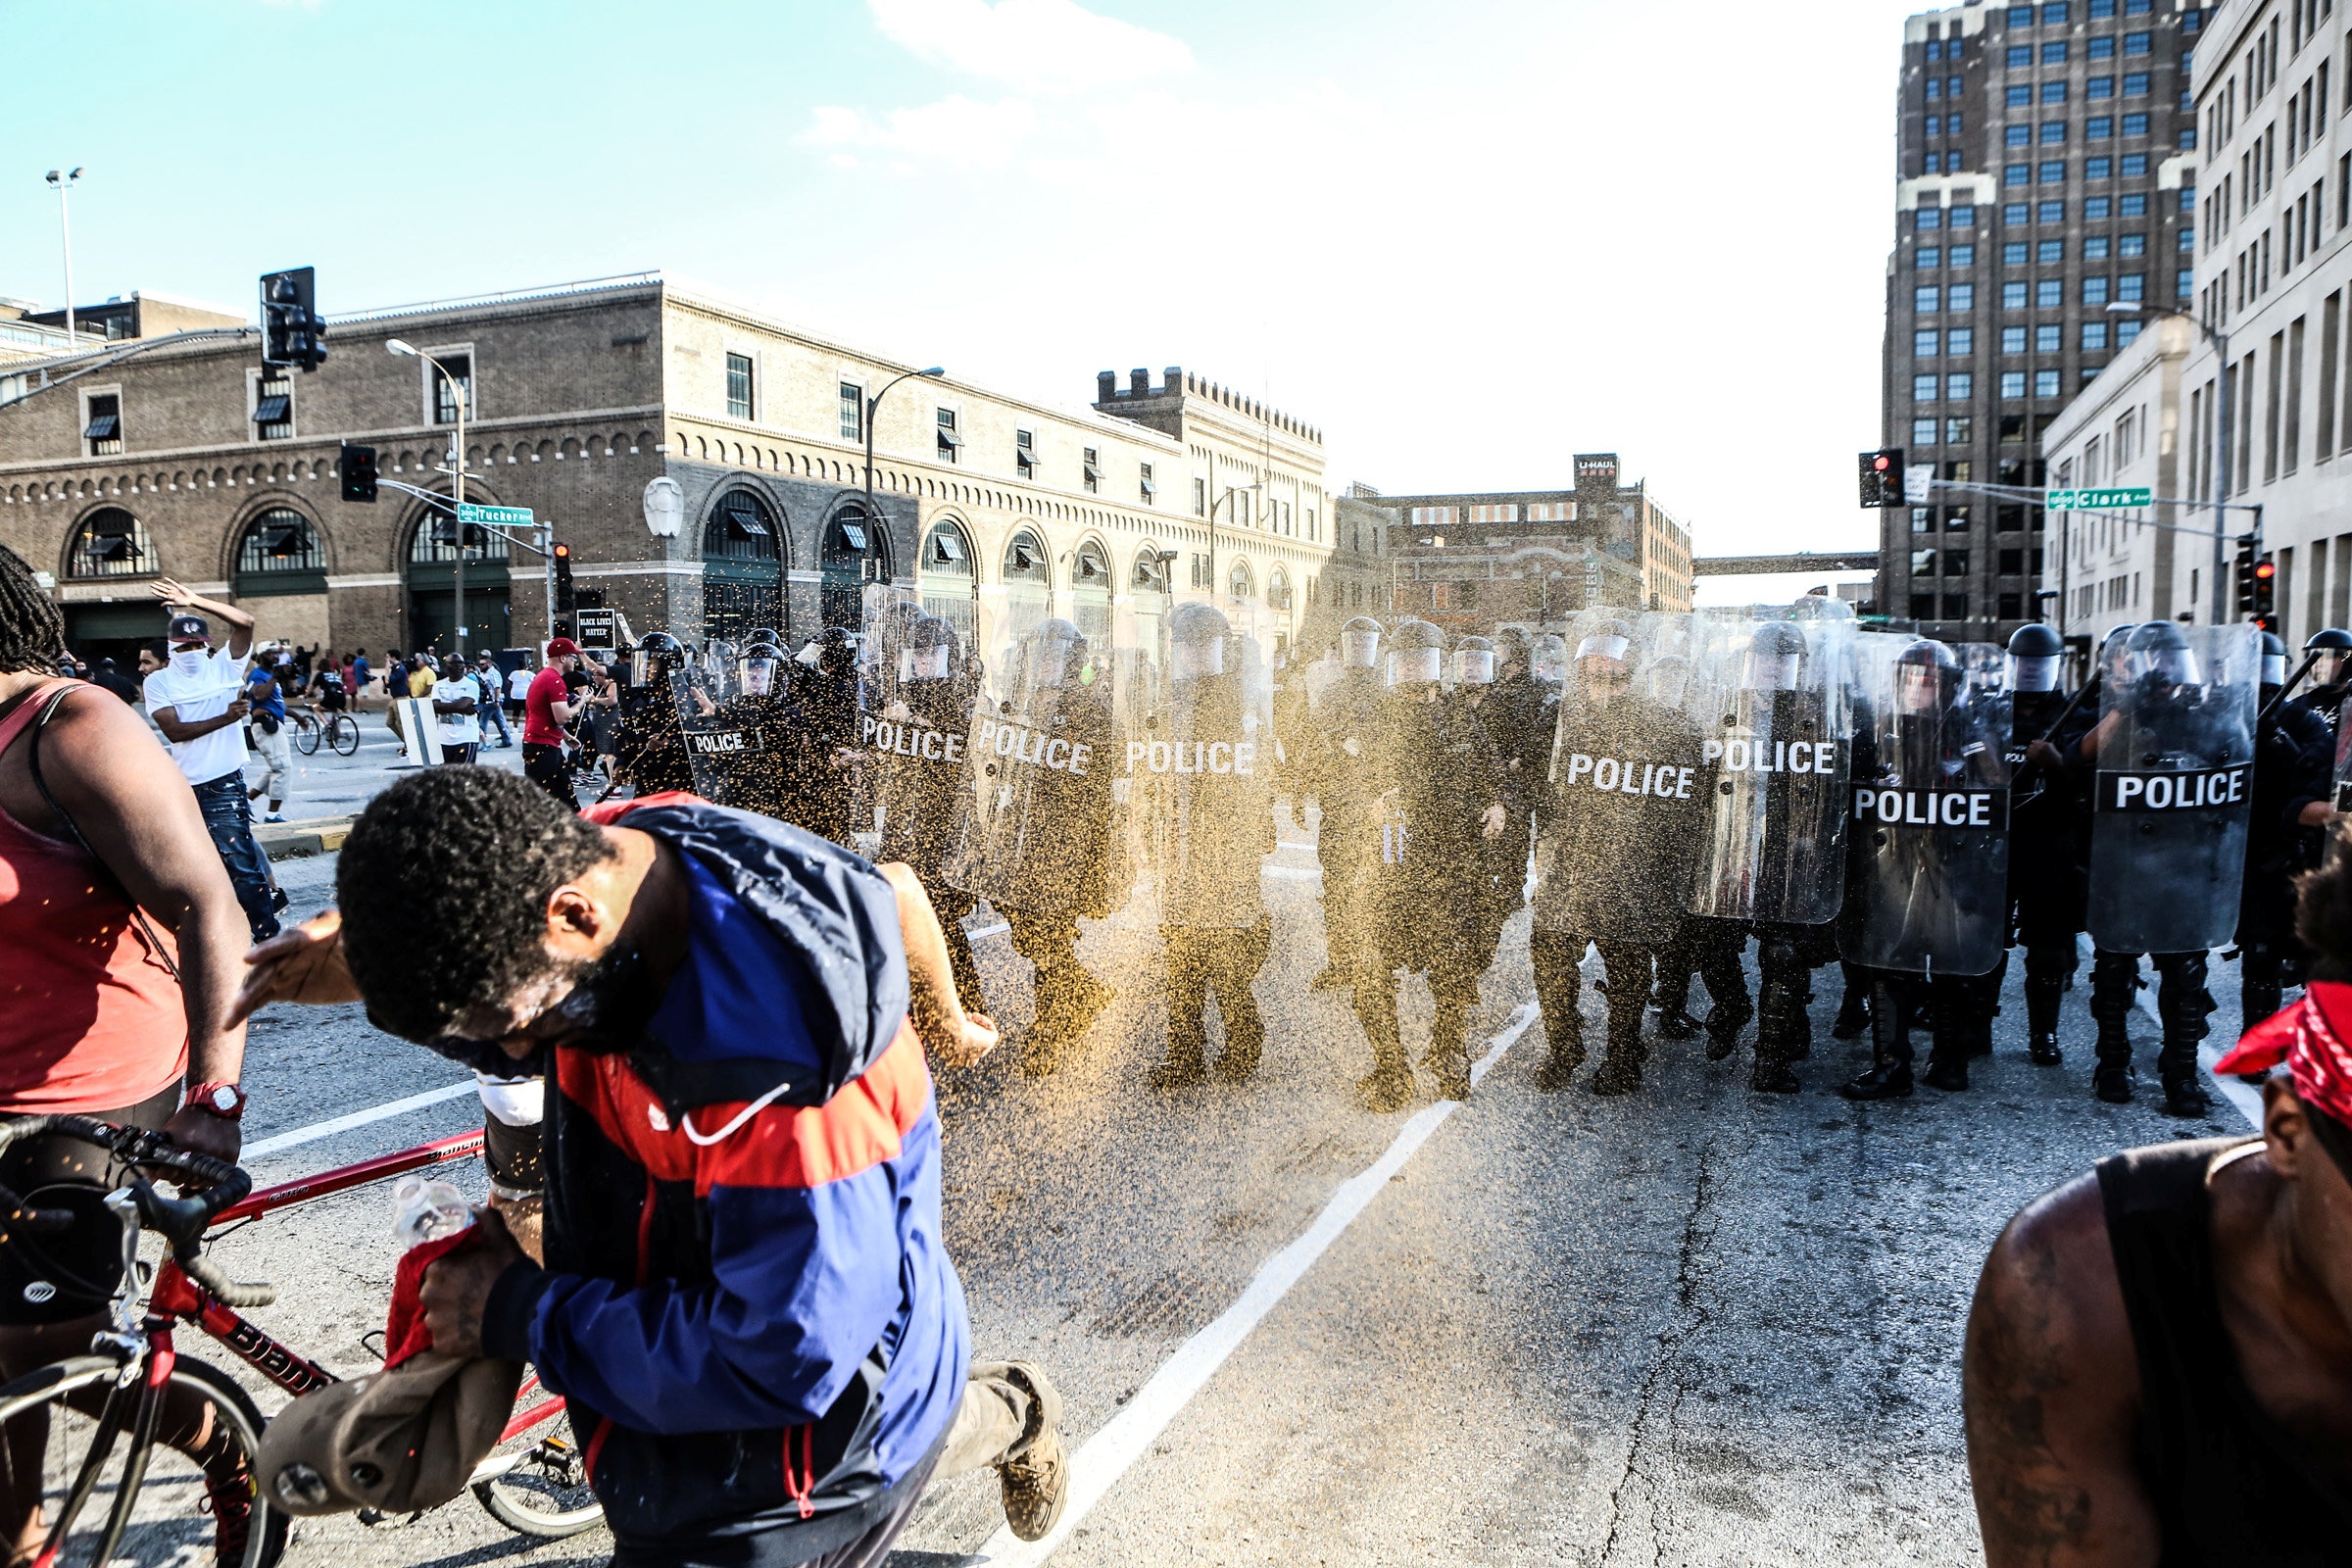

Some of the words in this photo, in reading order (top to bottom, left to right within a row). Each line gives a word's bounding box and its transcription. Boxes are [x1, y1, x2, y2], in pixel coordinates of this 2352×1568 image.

[479, 509, 518, 522] Tucker
[2079, 492, 2132, 506] Clark
[579, 617, 596, 626] BLACK
[596, 617, 612, 626] LIVES
[585, 627, 608, 636] MATTER
[694, 732, 745, 753] POLICE
[862, 715, 964, 763] POLICE
[977, 719, 1092, 776] POLICE
[1126, 741, 1254, 775] POLICE
[1702, 739, 1834, 774] POLICE
[1568, 754, 1694, 799] POLICE
[2116, 769, 2244, 808] POLICE
[1854, 789, 1991, 826] POLICE
